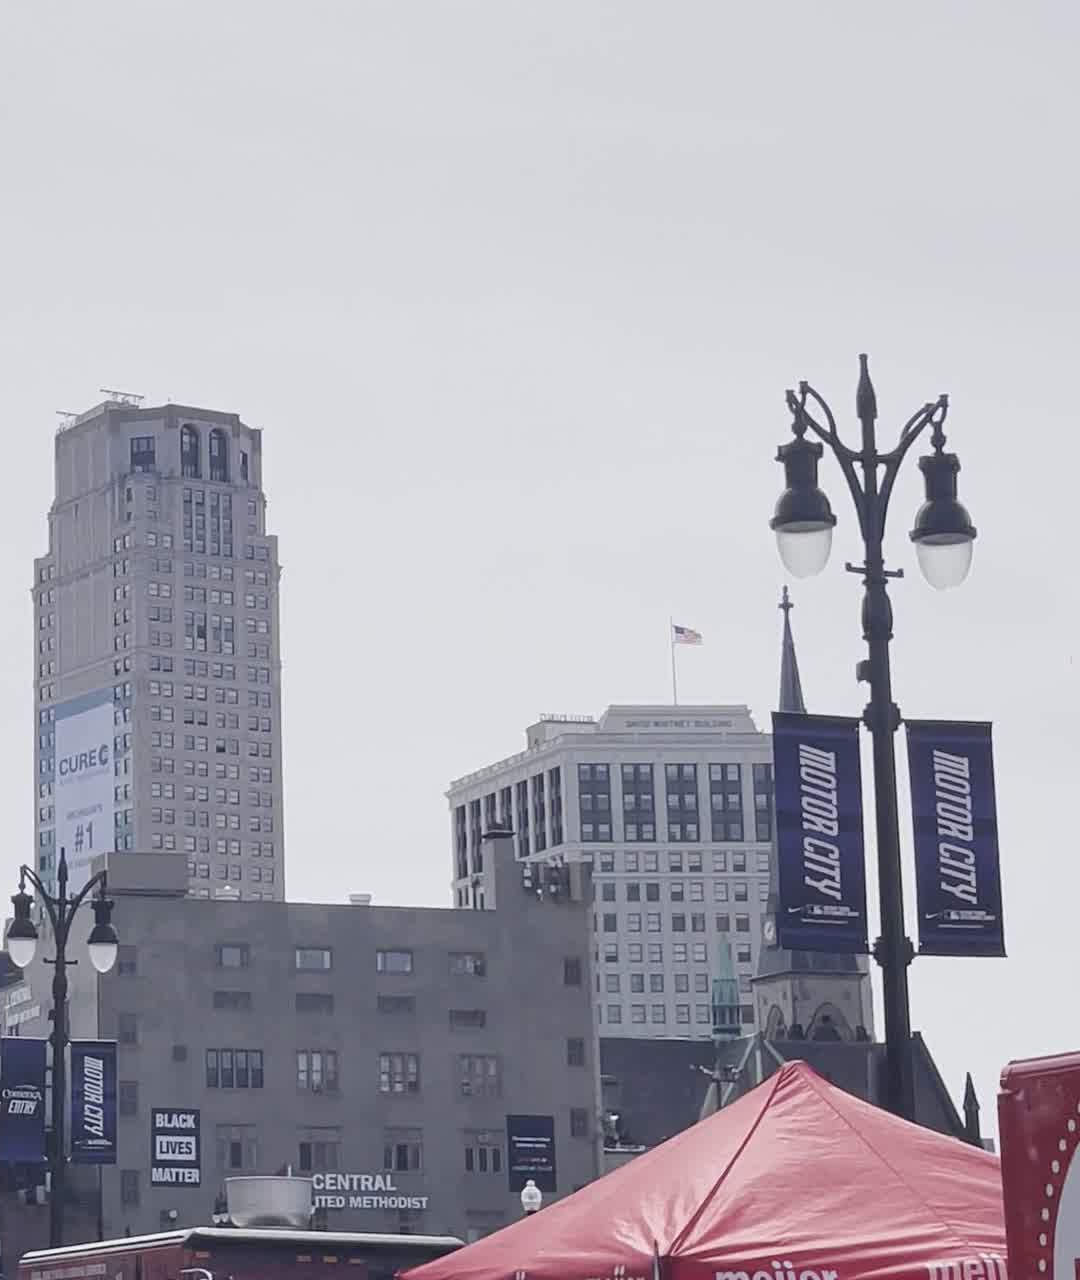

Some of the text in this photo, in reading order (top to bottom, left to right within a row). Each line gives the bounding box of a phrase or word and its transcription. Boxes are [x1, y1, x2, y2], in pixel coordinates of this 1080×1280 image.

[59, 749, 97, 776] CURE
[799, 743, 839, 837] MOTOR
[933, 749, 974, 842] MOTOR
[74, 821, 94, 853] #1
[803, 836, 842, 901] CITY
[938, 842, 978, 904] CITY
[84, 1056, 104, 1104] MOTOR
[8, 1099, 38, 1115] ENTRY
[84, 1102, 104, 1137] CITY
[156, 1113, 196, 1128] BLACK
[159, 1141, 193, 1155] LIVES
[152, 1168, 200, 1183] MATTER
[312, 1174, 397, 1192] CENTRAL
[349, 1196, 429, 1209] METHODIST
